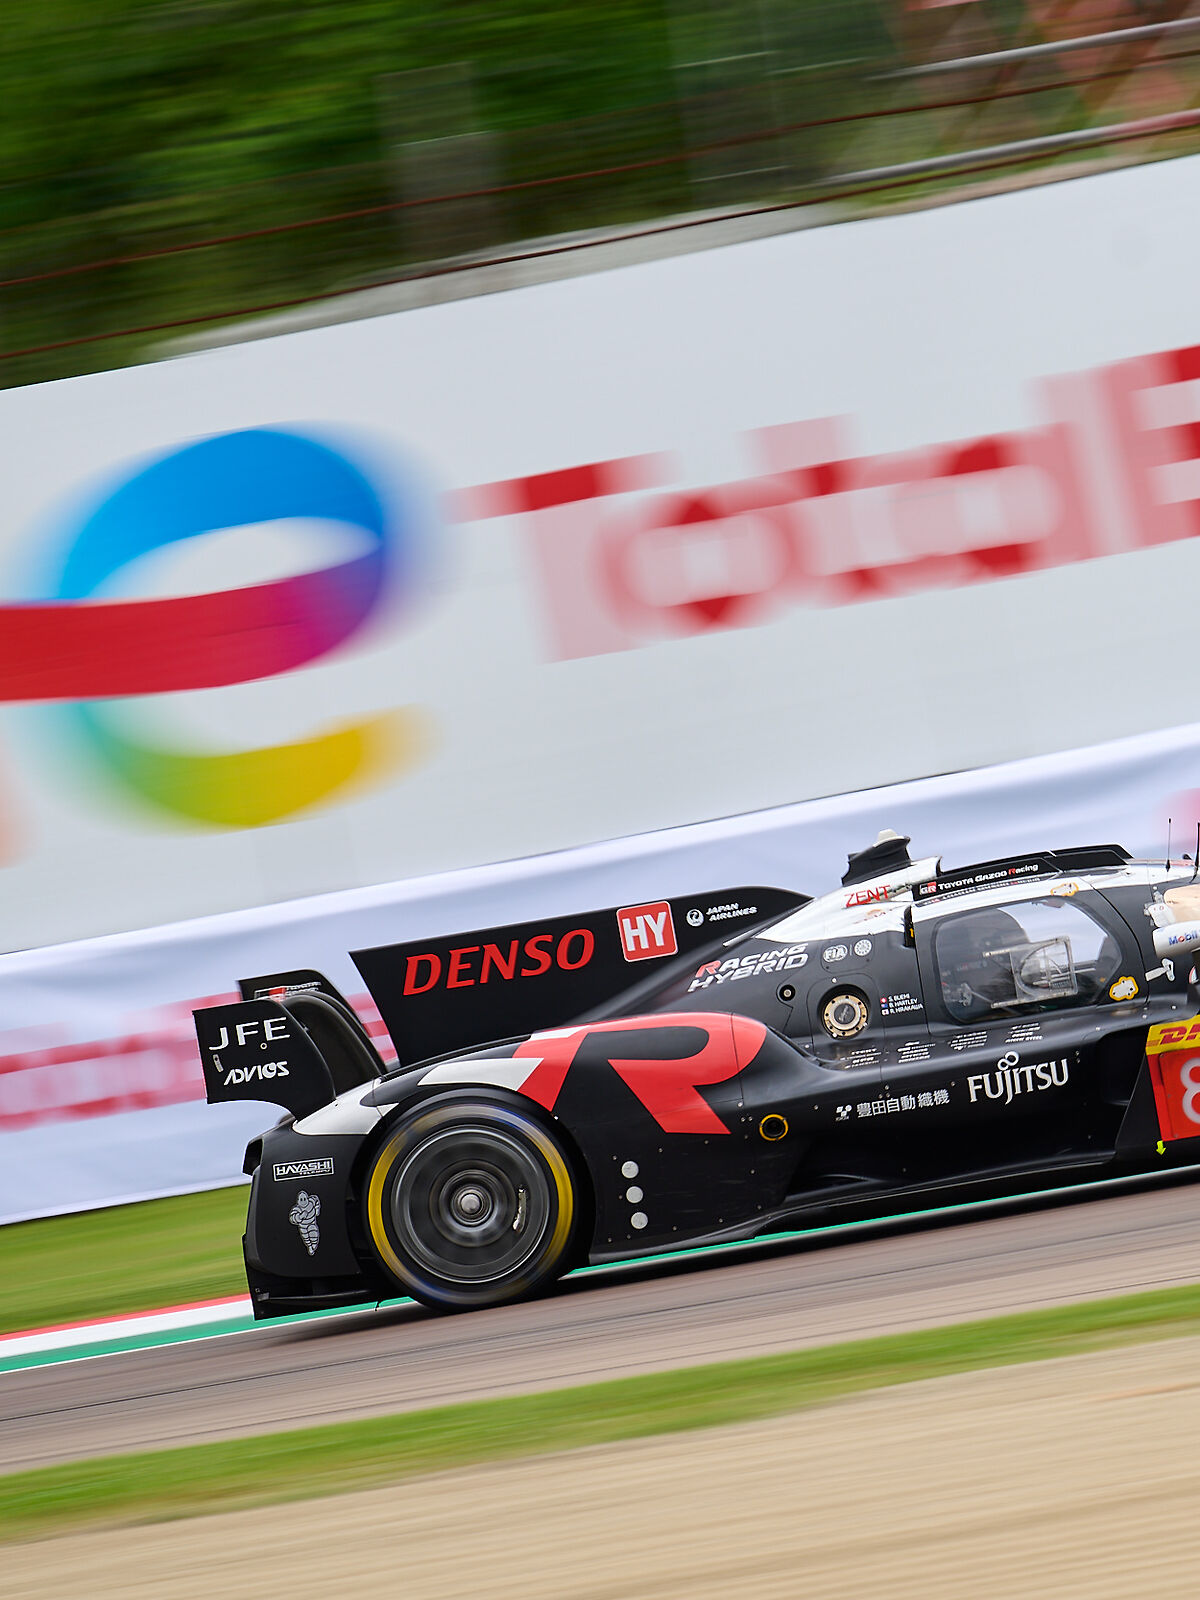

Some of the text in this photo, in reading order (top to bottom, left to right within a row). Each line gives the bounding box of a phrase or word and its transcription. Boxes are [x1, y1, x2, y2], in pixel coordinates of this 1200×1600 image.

[938, 877, 975, 891] TOYOTA
[974, 870, 1008, 883] GAZOO
[1008, 864, 1039, 877] Racing
[844, 884, 890, 908] ZENT
[706, 903, 739, 915] JAPAN
[709, 906, 757, 921] AIRLINES
[621, 911, 667, 952] HY
[1168, 930, 1198, 946] Mobil
[402, 928, 596, 996] DENSO
[695, 943, 808, 978] RACING
[824, 946, 848, 961] FIA
[687, 953, 808, 993] HYBRID
[894, 998, 918, 1007] HARTLEY
[208, 1016, 291, 1051] JFE
[966, 1058, 1070, 1105] FUJITSU
[276, 1160, 331, 1176] HAYASHI
